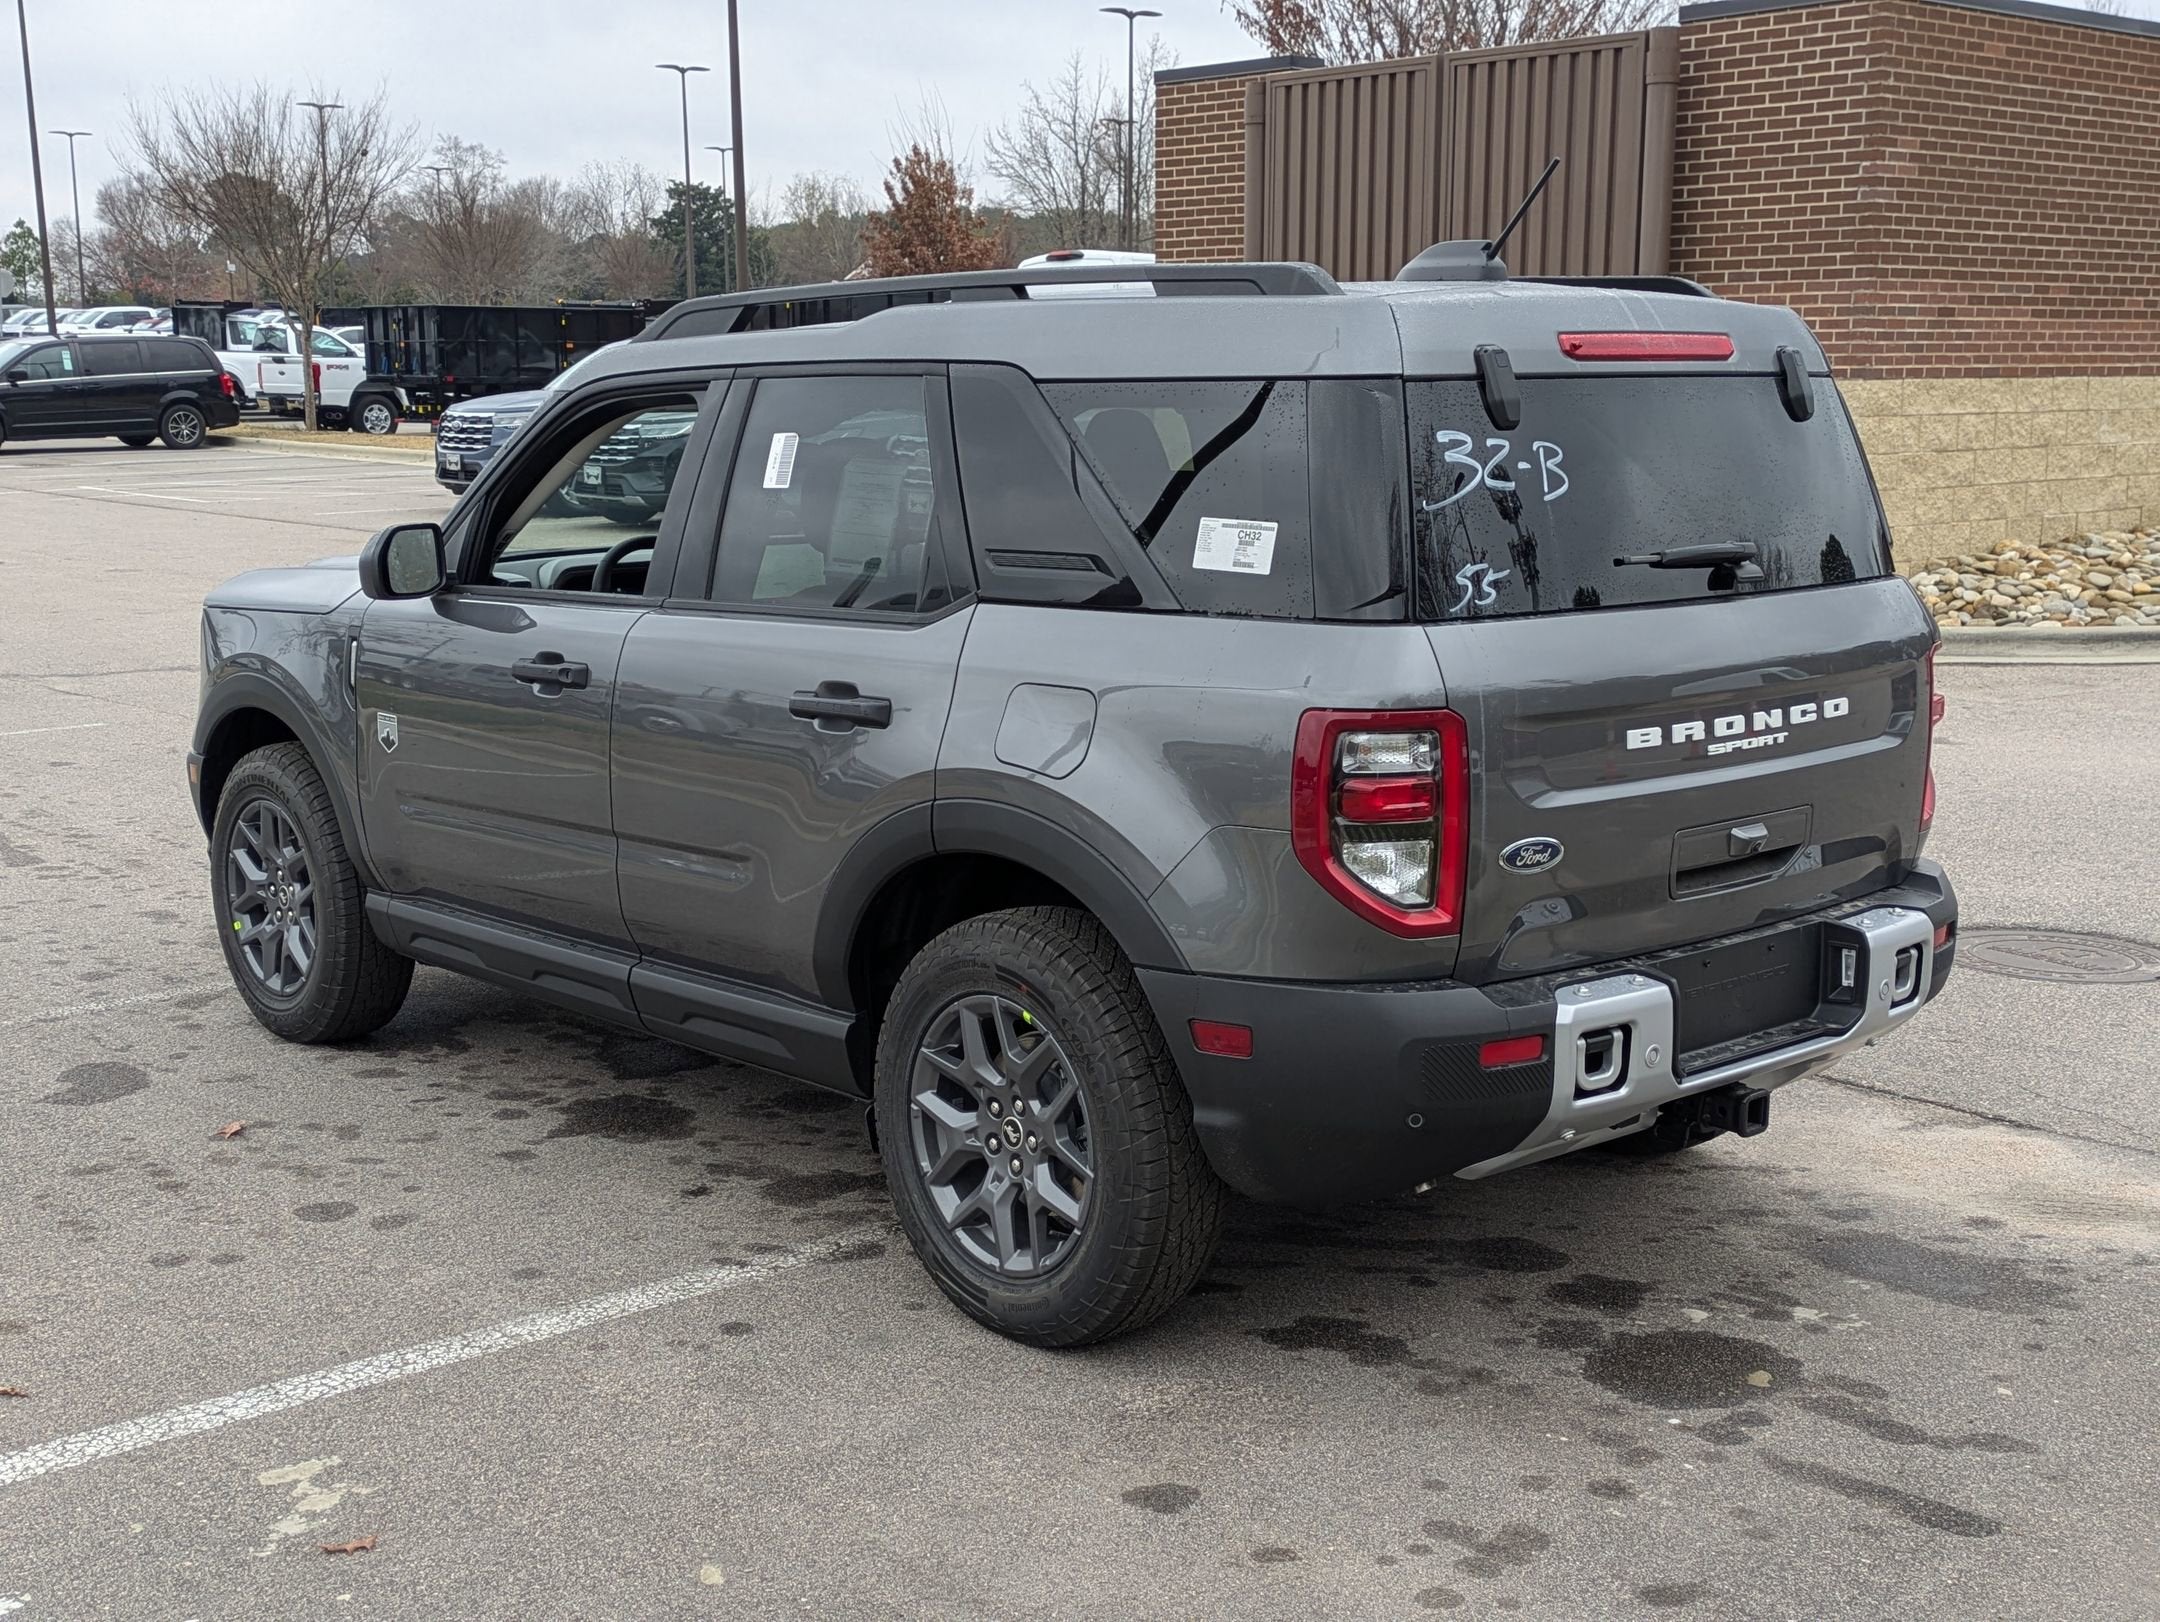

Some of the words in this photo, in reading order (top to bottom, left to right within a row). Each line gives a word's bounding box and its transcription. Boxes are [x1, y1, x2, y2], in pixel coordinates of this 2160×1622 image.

[1423, 430, 1569, 511] 32-B
[1237, 529, 1262, 541] CH32
[1626, 697, 1849, 750] BRONCO
[1707, 732, 1789, 756] SPORT
[1516, 844, 1552, 867] Ford
